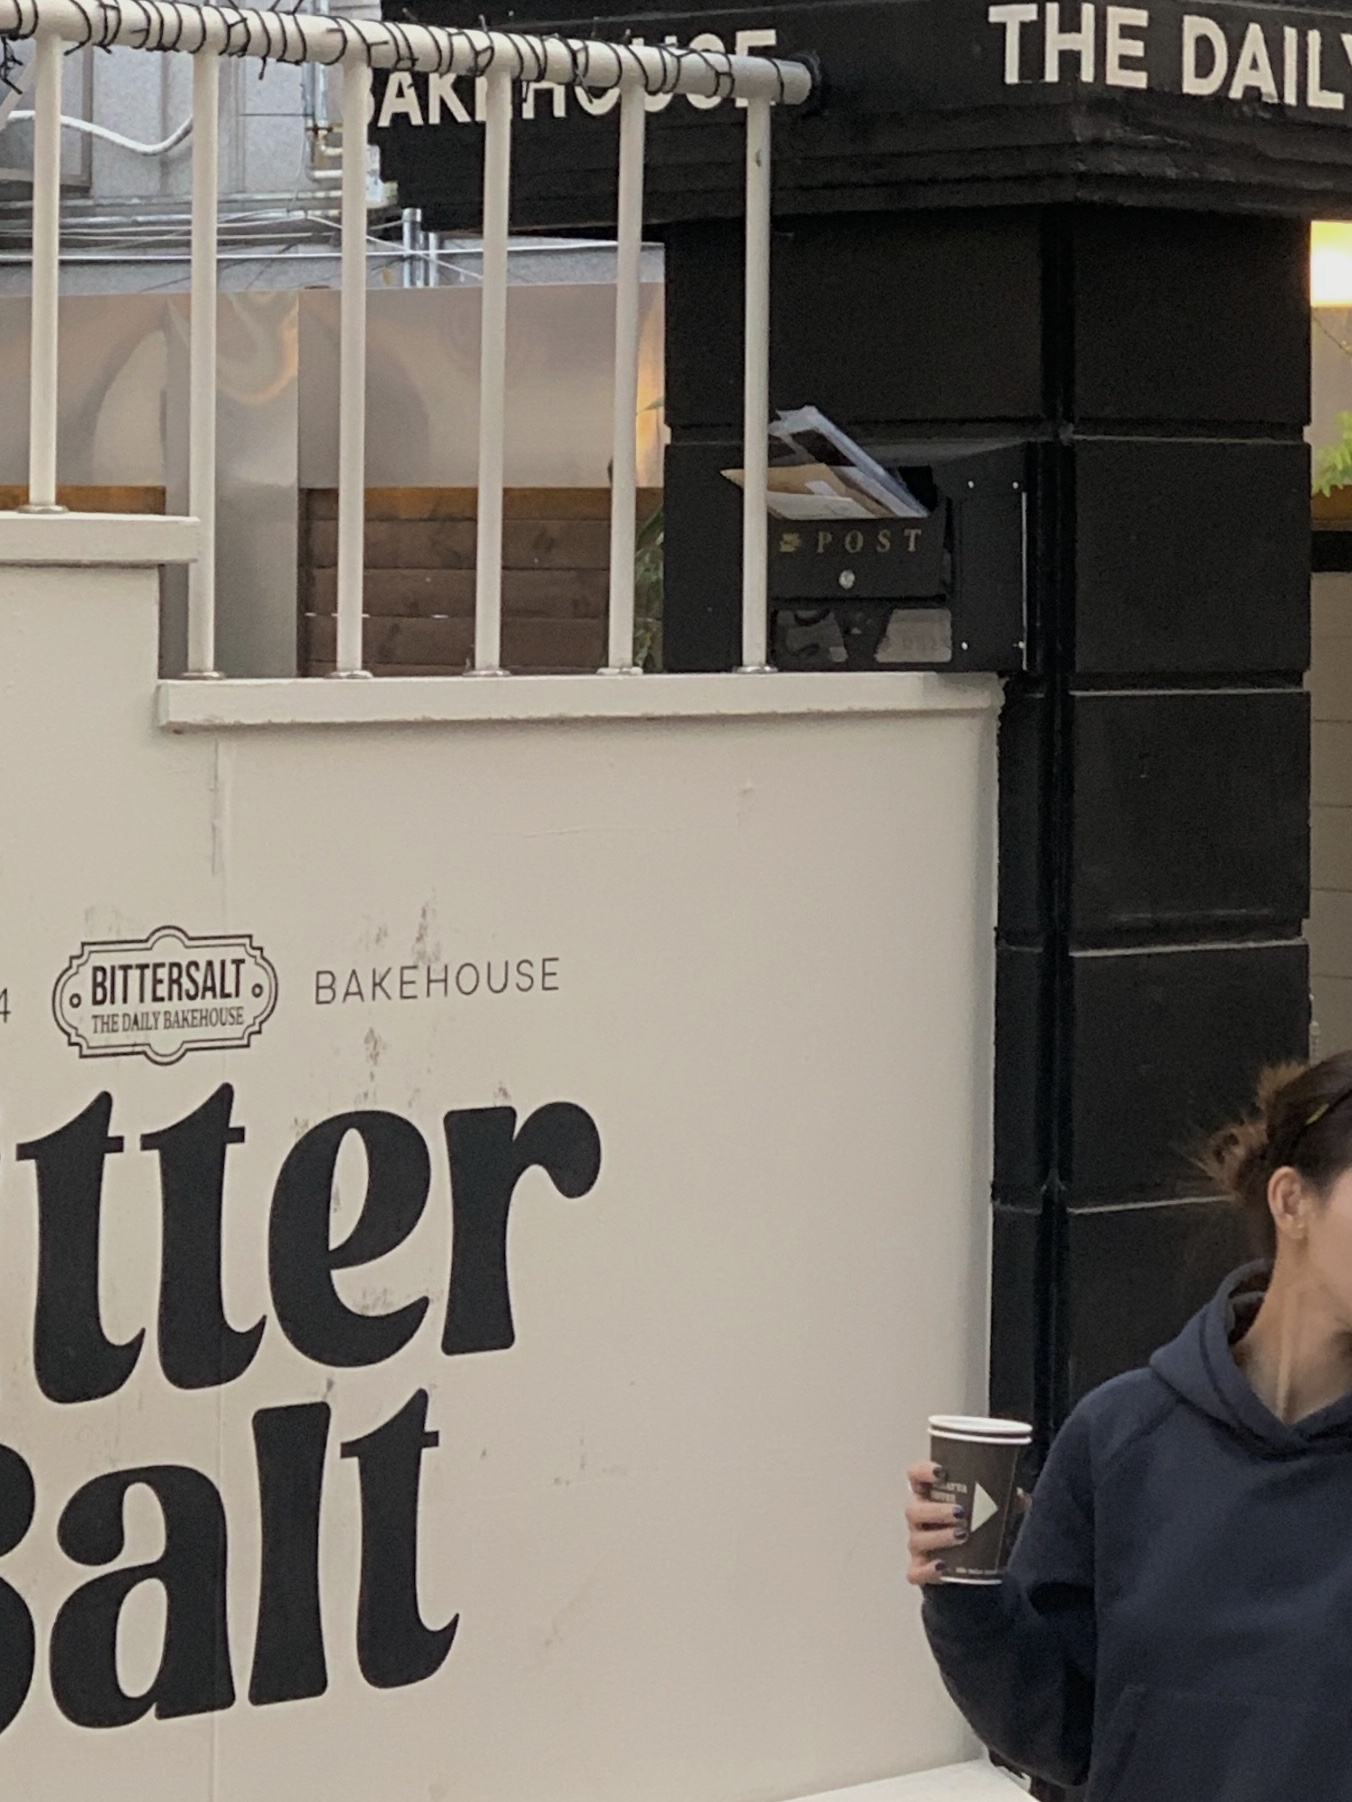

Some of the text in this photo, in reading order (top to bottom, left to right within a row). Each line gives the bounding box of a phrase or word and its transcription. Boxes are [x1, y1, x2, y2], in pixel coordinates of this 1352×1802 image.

[989, 3, 1148, 88] THE
[816, 528, 922, 553] POST
[92, 959, 245, 1006] BITTERSALT
[316, 958, 559, 1004] BAKEHOUSE
[92, 1006, 245, 1033] THE DAILY BAKEHOUSE
[0, 1389, 459, 1734] alt
